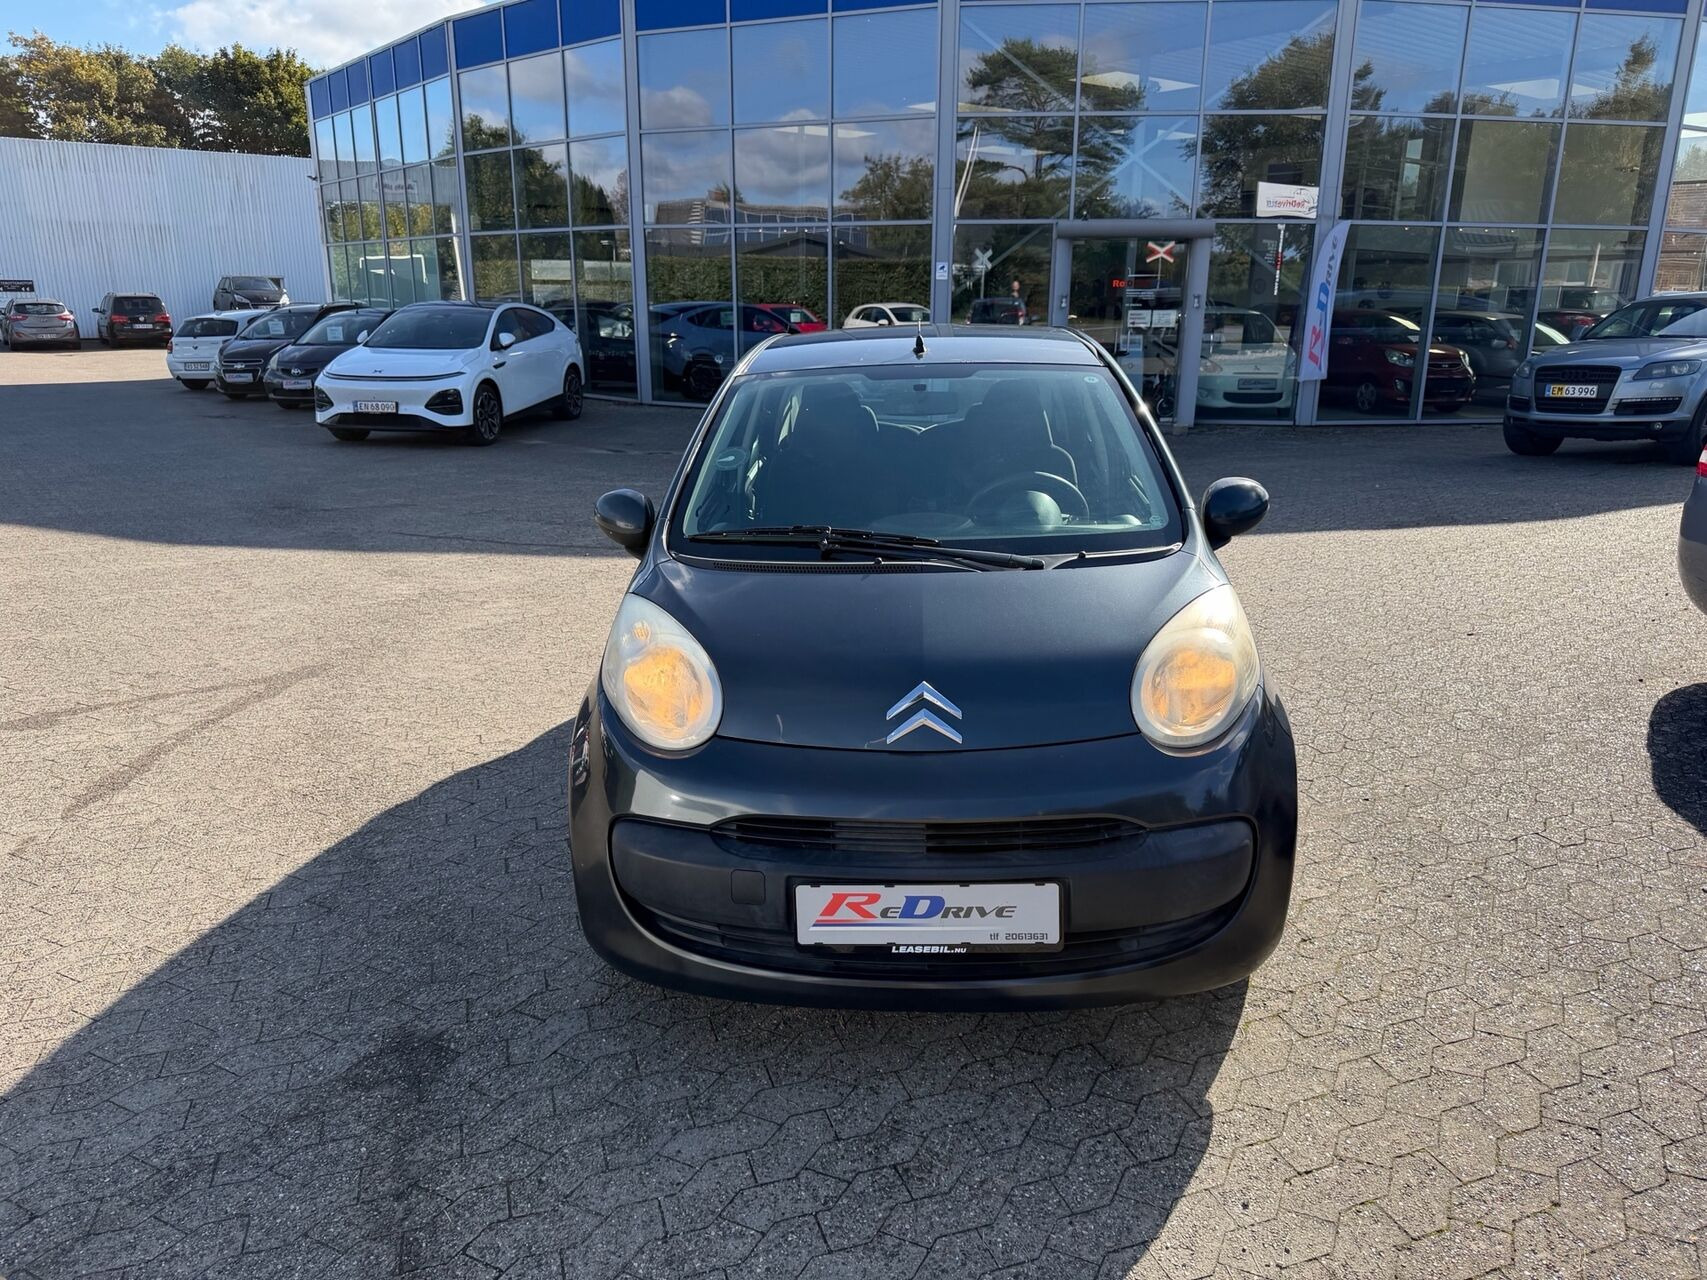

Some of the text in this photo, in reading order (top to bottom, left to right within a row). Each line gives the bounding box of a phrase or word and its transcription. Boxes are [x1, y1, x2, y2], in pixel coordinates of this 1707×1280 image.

[1551, 386, 1595, 396] EM 63 996
[1004, 933, 1048, 941] 20613631
[891, 945, 967, 954] LEASEBIL.NU
